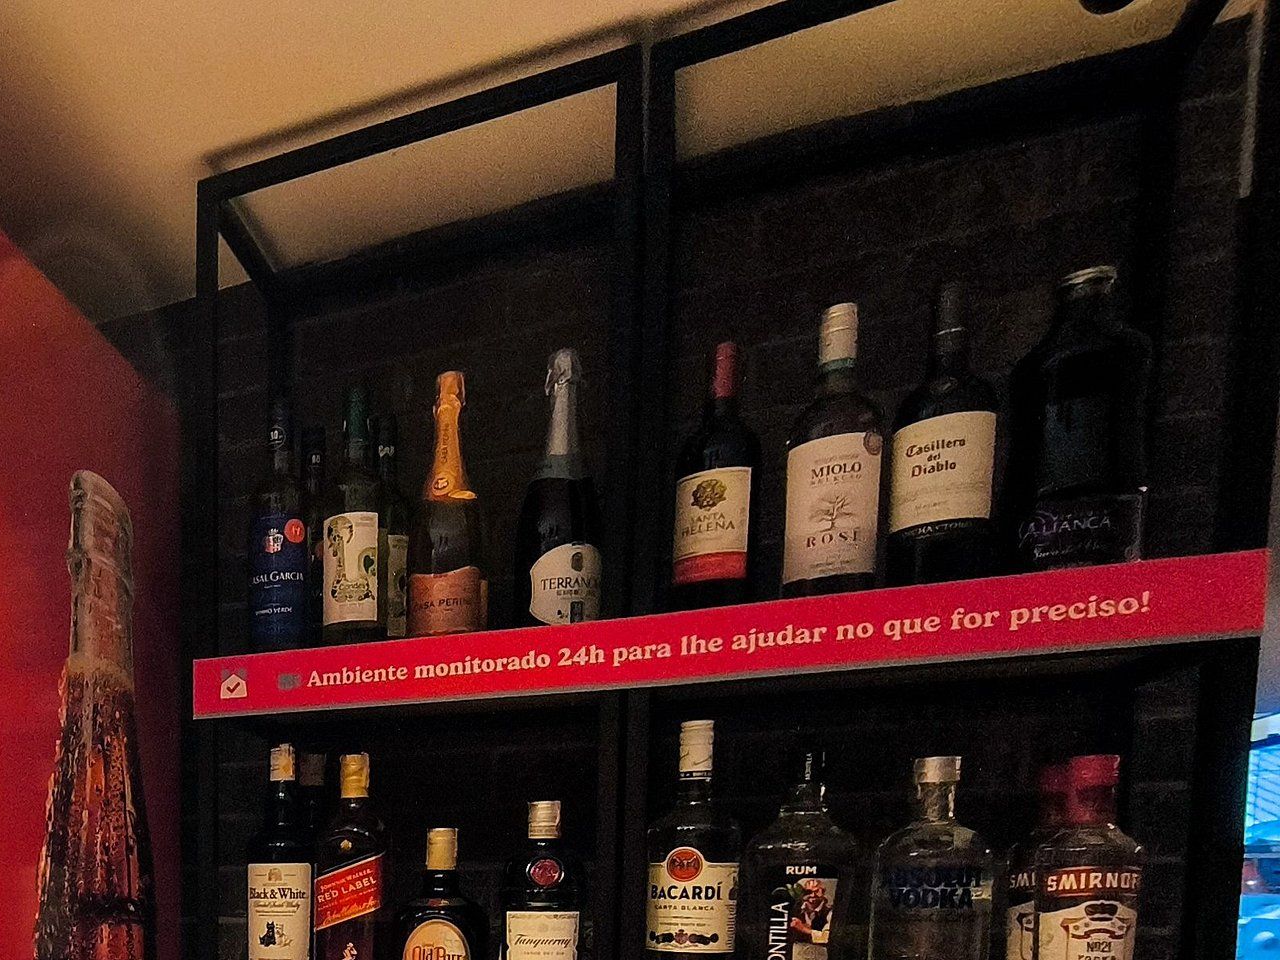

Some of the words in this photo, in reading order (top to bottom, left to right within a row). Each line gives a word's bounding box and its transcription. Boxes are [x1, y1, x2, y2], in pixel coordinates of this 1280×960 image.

[811, 461, 862, 479] MIOLO
[911, 461, 957, 478] Diablo
[307, 665, 408, 688] Ambiente
[414, 650, 551, 680] monitorado
[557, 644, 605, 668] 24h
[612, 641, 671, 668] para
[680, 634, 723, 656] lhe
[731, 622, 826, 654] ajudar
[836, 621, 874, 641] no
[883, 614, 940, 642] que
[950, 607, 1000, 632] for
[1009, 591, 1151, 631] preciso!
[786, 865, 817, 875] RUM
[317, 888, 339, 904] RED
[341, 876, 377, 896] LABEL
[651, 882, 723, 901] BACARDÍ
